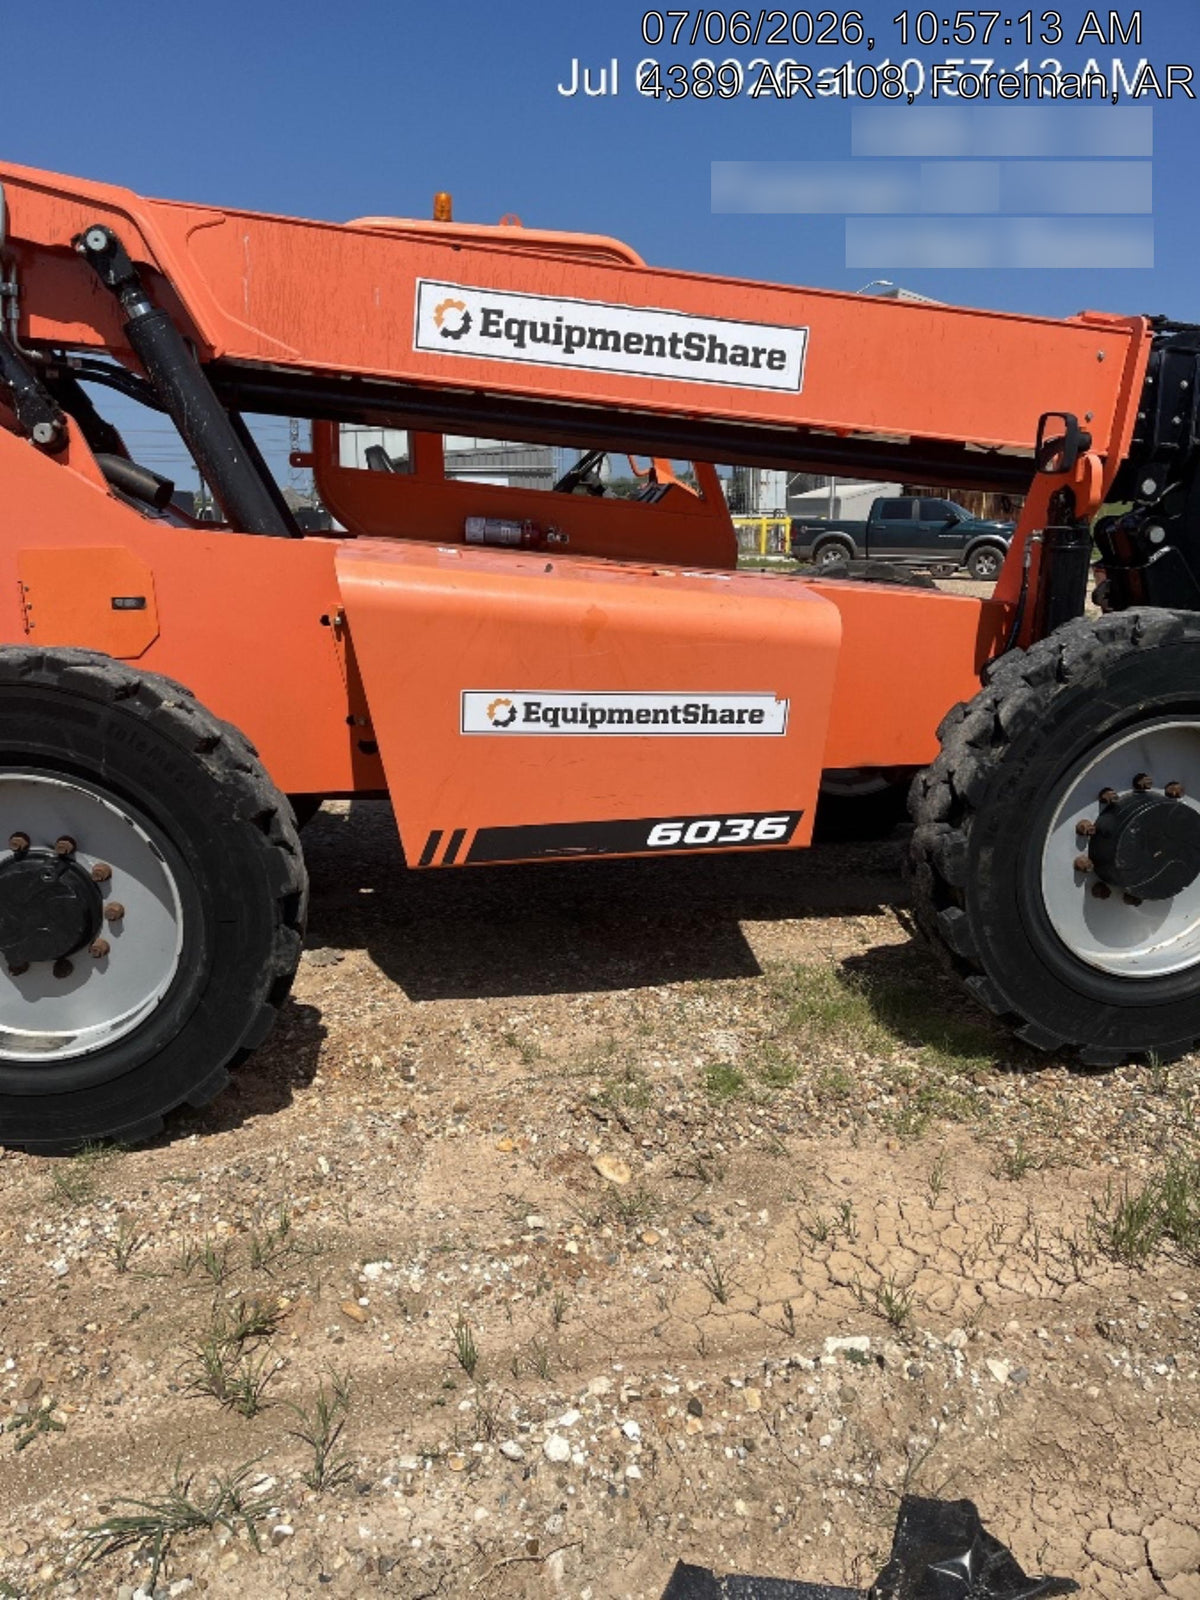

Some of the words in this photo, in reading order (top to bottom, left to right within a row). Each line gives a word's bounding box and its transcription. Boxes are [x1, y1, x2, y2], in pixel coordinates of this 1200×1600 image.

[479, 308, 787, 371] EquipmentShare
[522, 701, 764, 728] EquipmentShare
[646, 816, 790, 847] 6036
